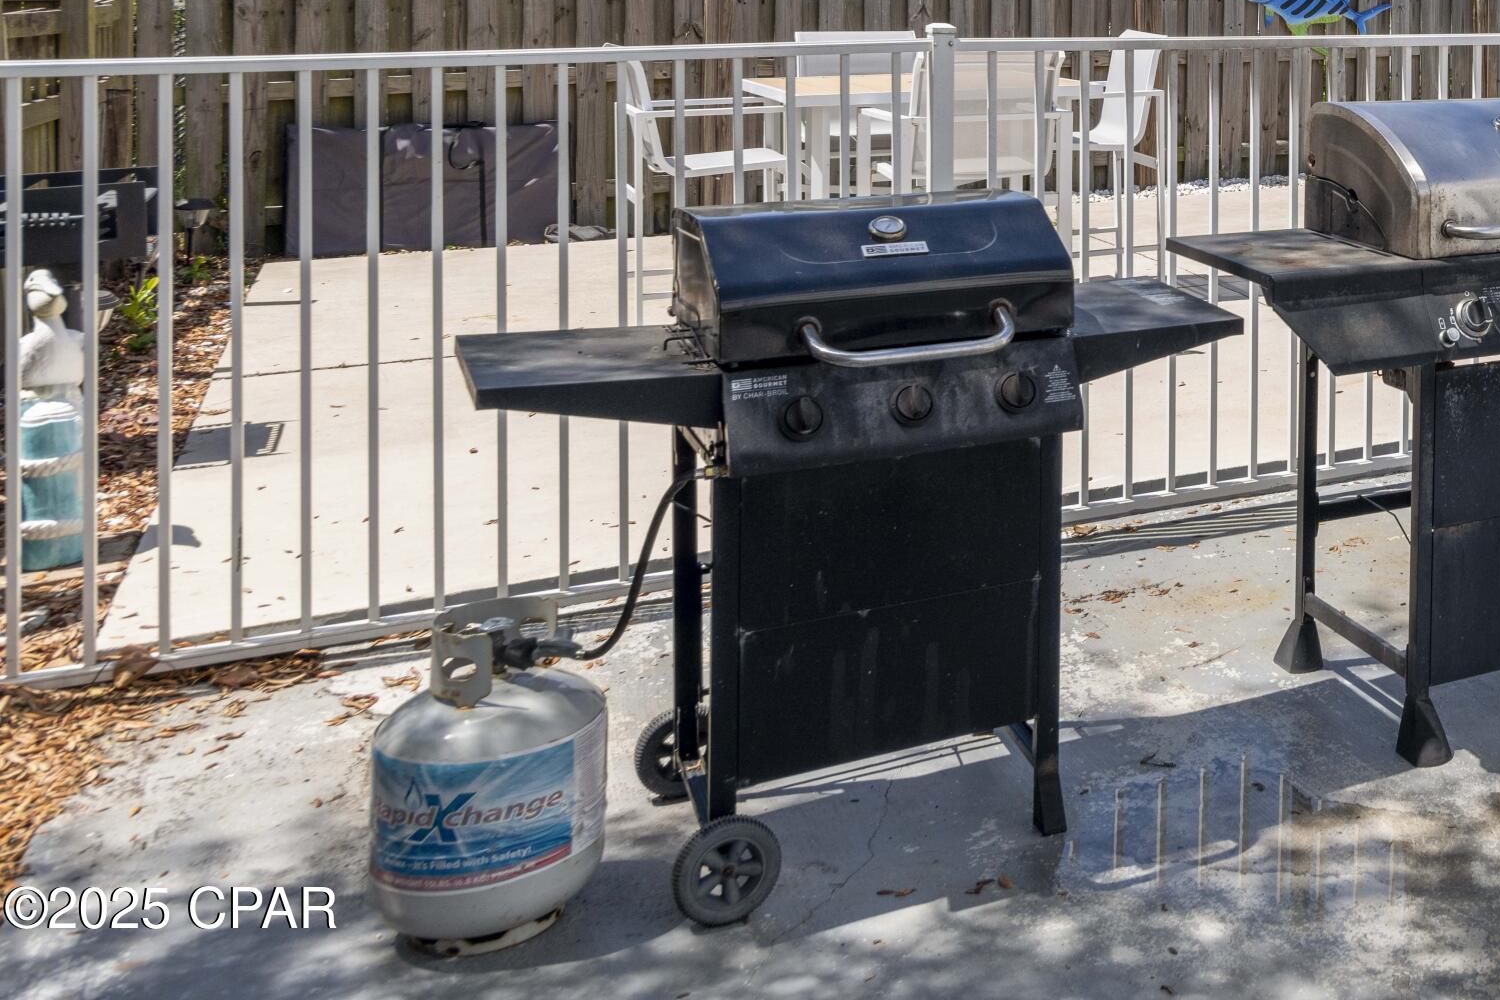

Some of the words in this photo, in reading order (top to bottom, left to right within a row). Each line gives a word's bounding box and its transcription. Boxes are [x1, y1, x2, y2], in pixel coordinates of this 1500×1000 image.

[752, 374, 788, 383] AMERICAN
[731, 393, 741, 401] BY
[743, 389, 789, 400] CHAR-BROIL
[430, 858, 460, 870] Filled
[491, 845, 533, 863] Safety!
